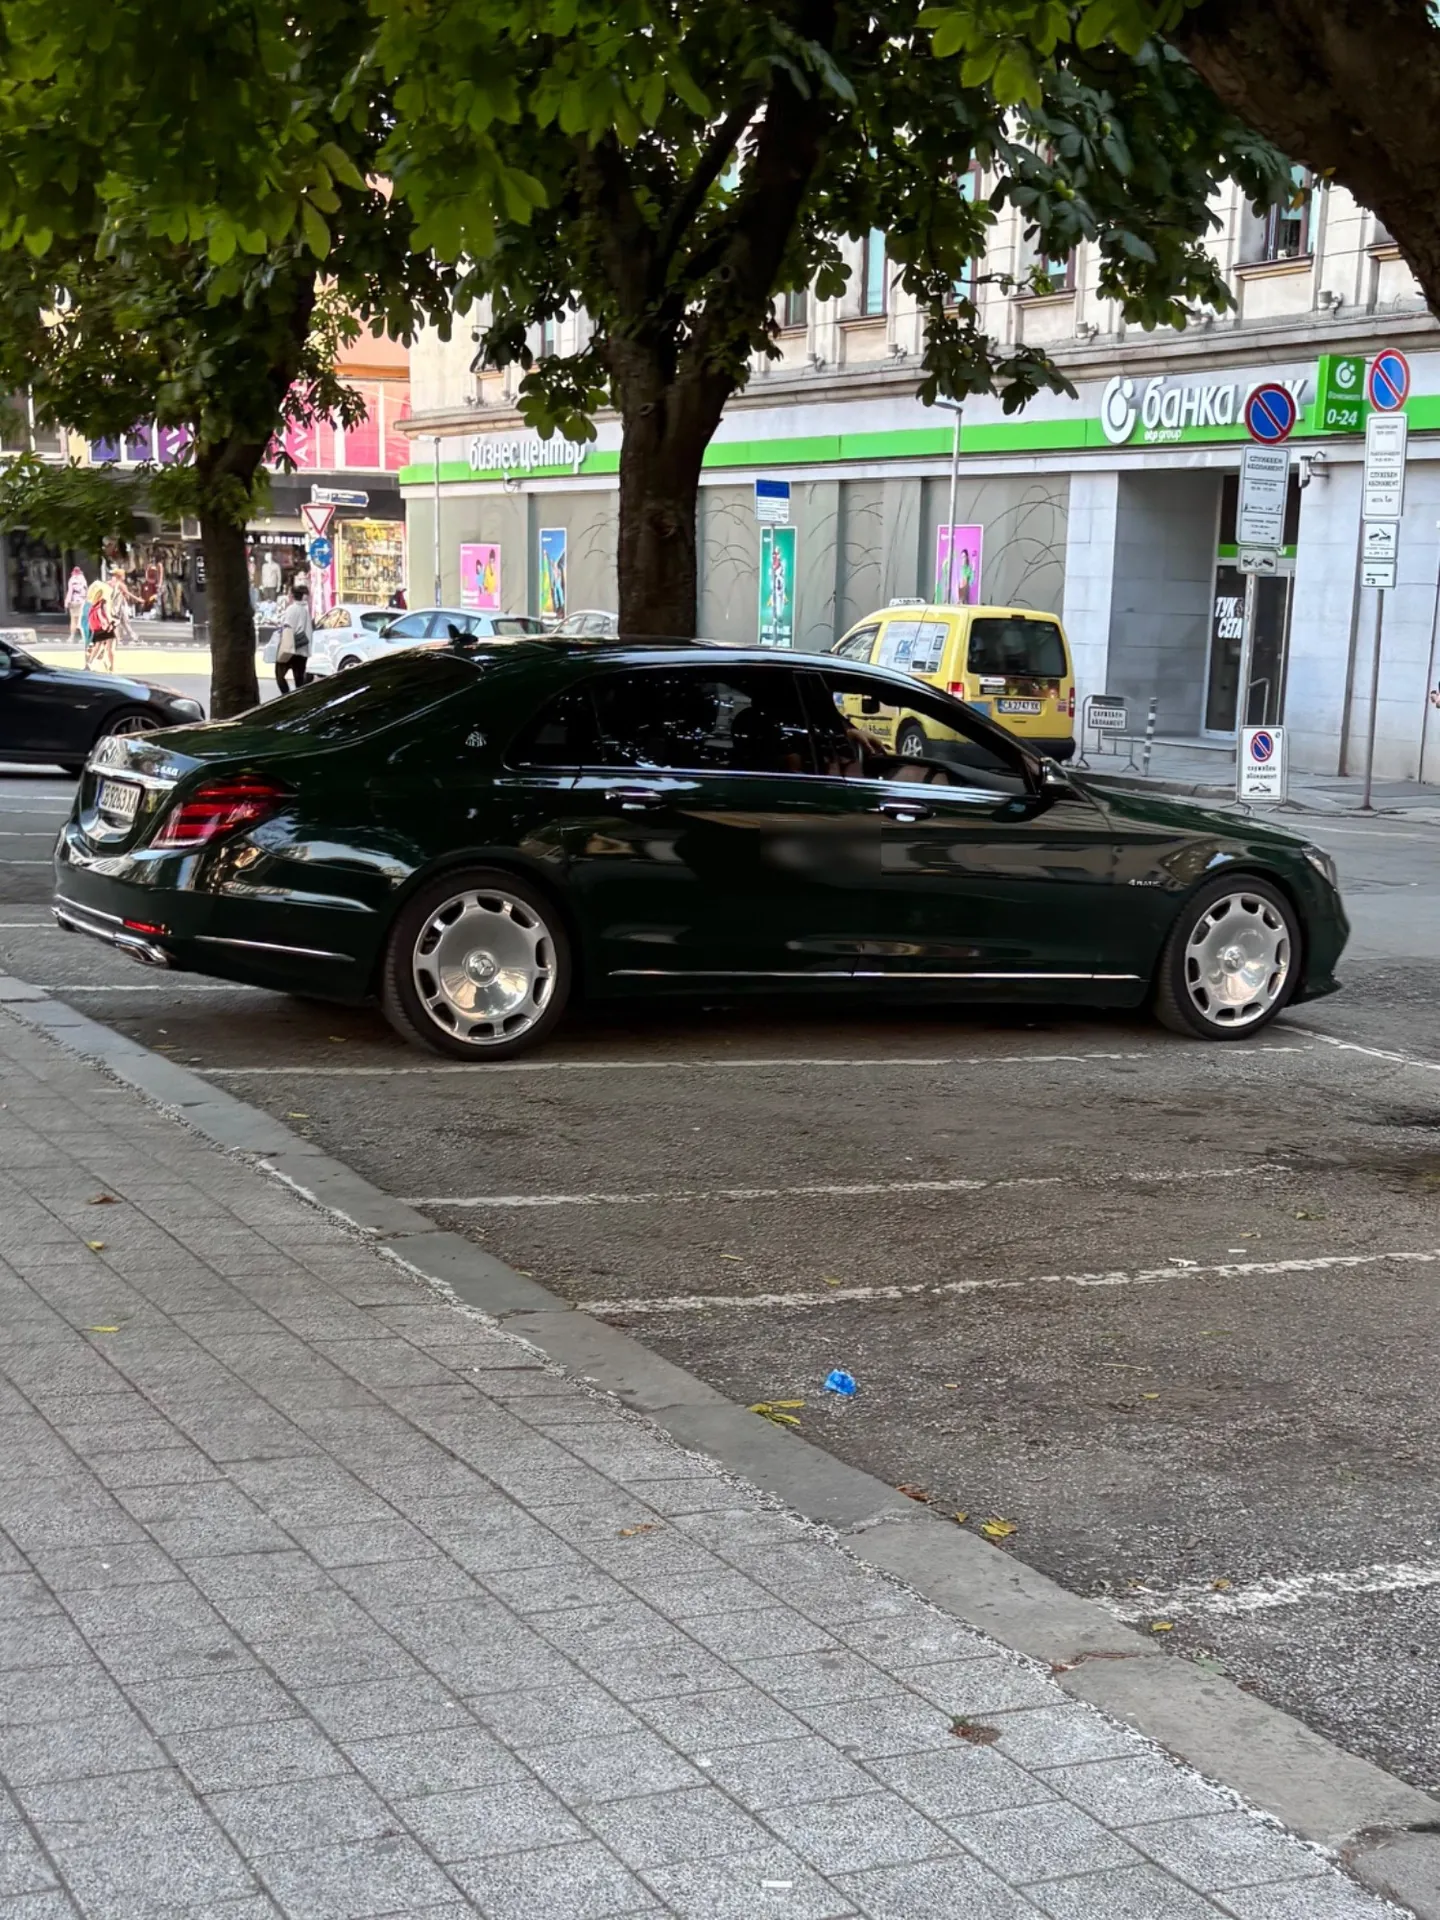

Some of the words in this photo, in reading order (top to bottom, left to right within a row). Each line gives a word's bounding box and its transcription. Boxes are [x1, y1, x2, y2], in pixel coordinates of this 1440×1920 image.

[1142, 376, 1236, 428] банка
[1327, 408, 1358, 426] 0-24
[470, 437, 519, 472] бизнес
[1215, 596, 1238, 617] ТУК
